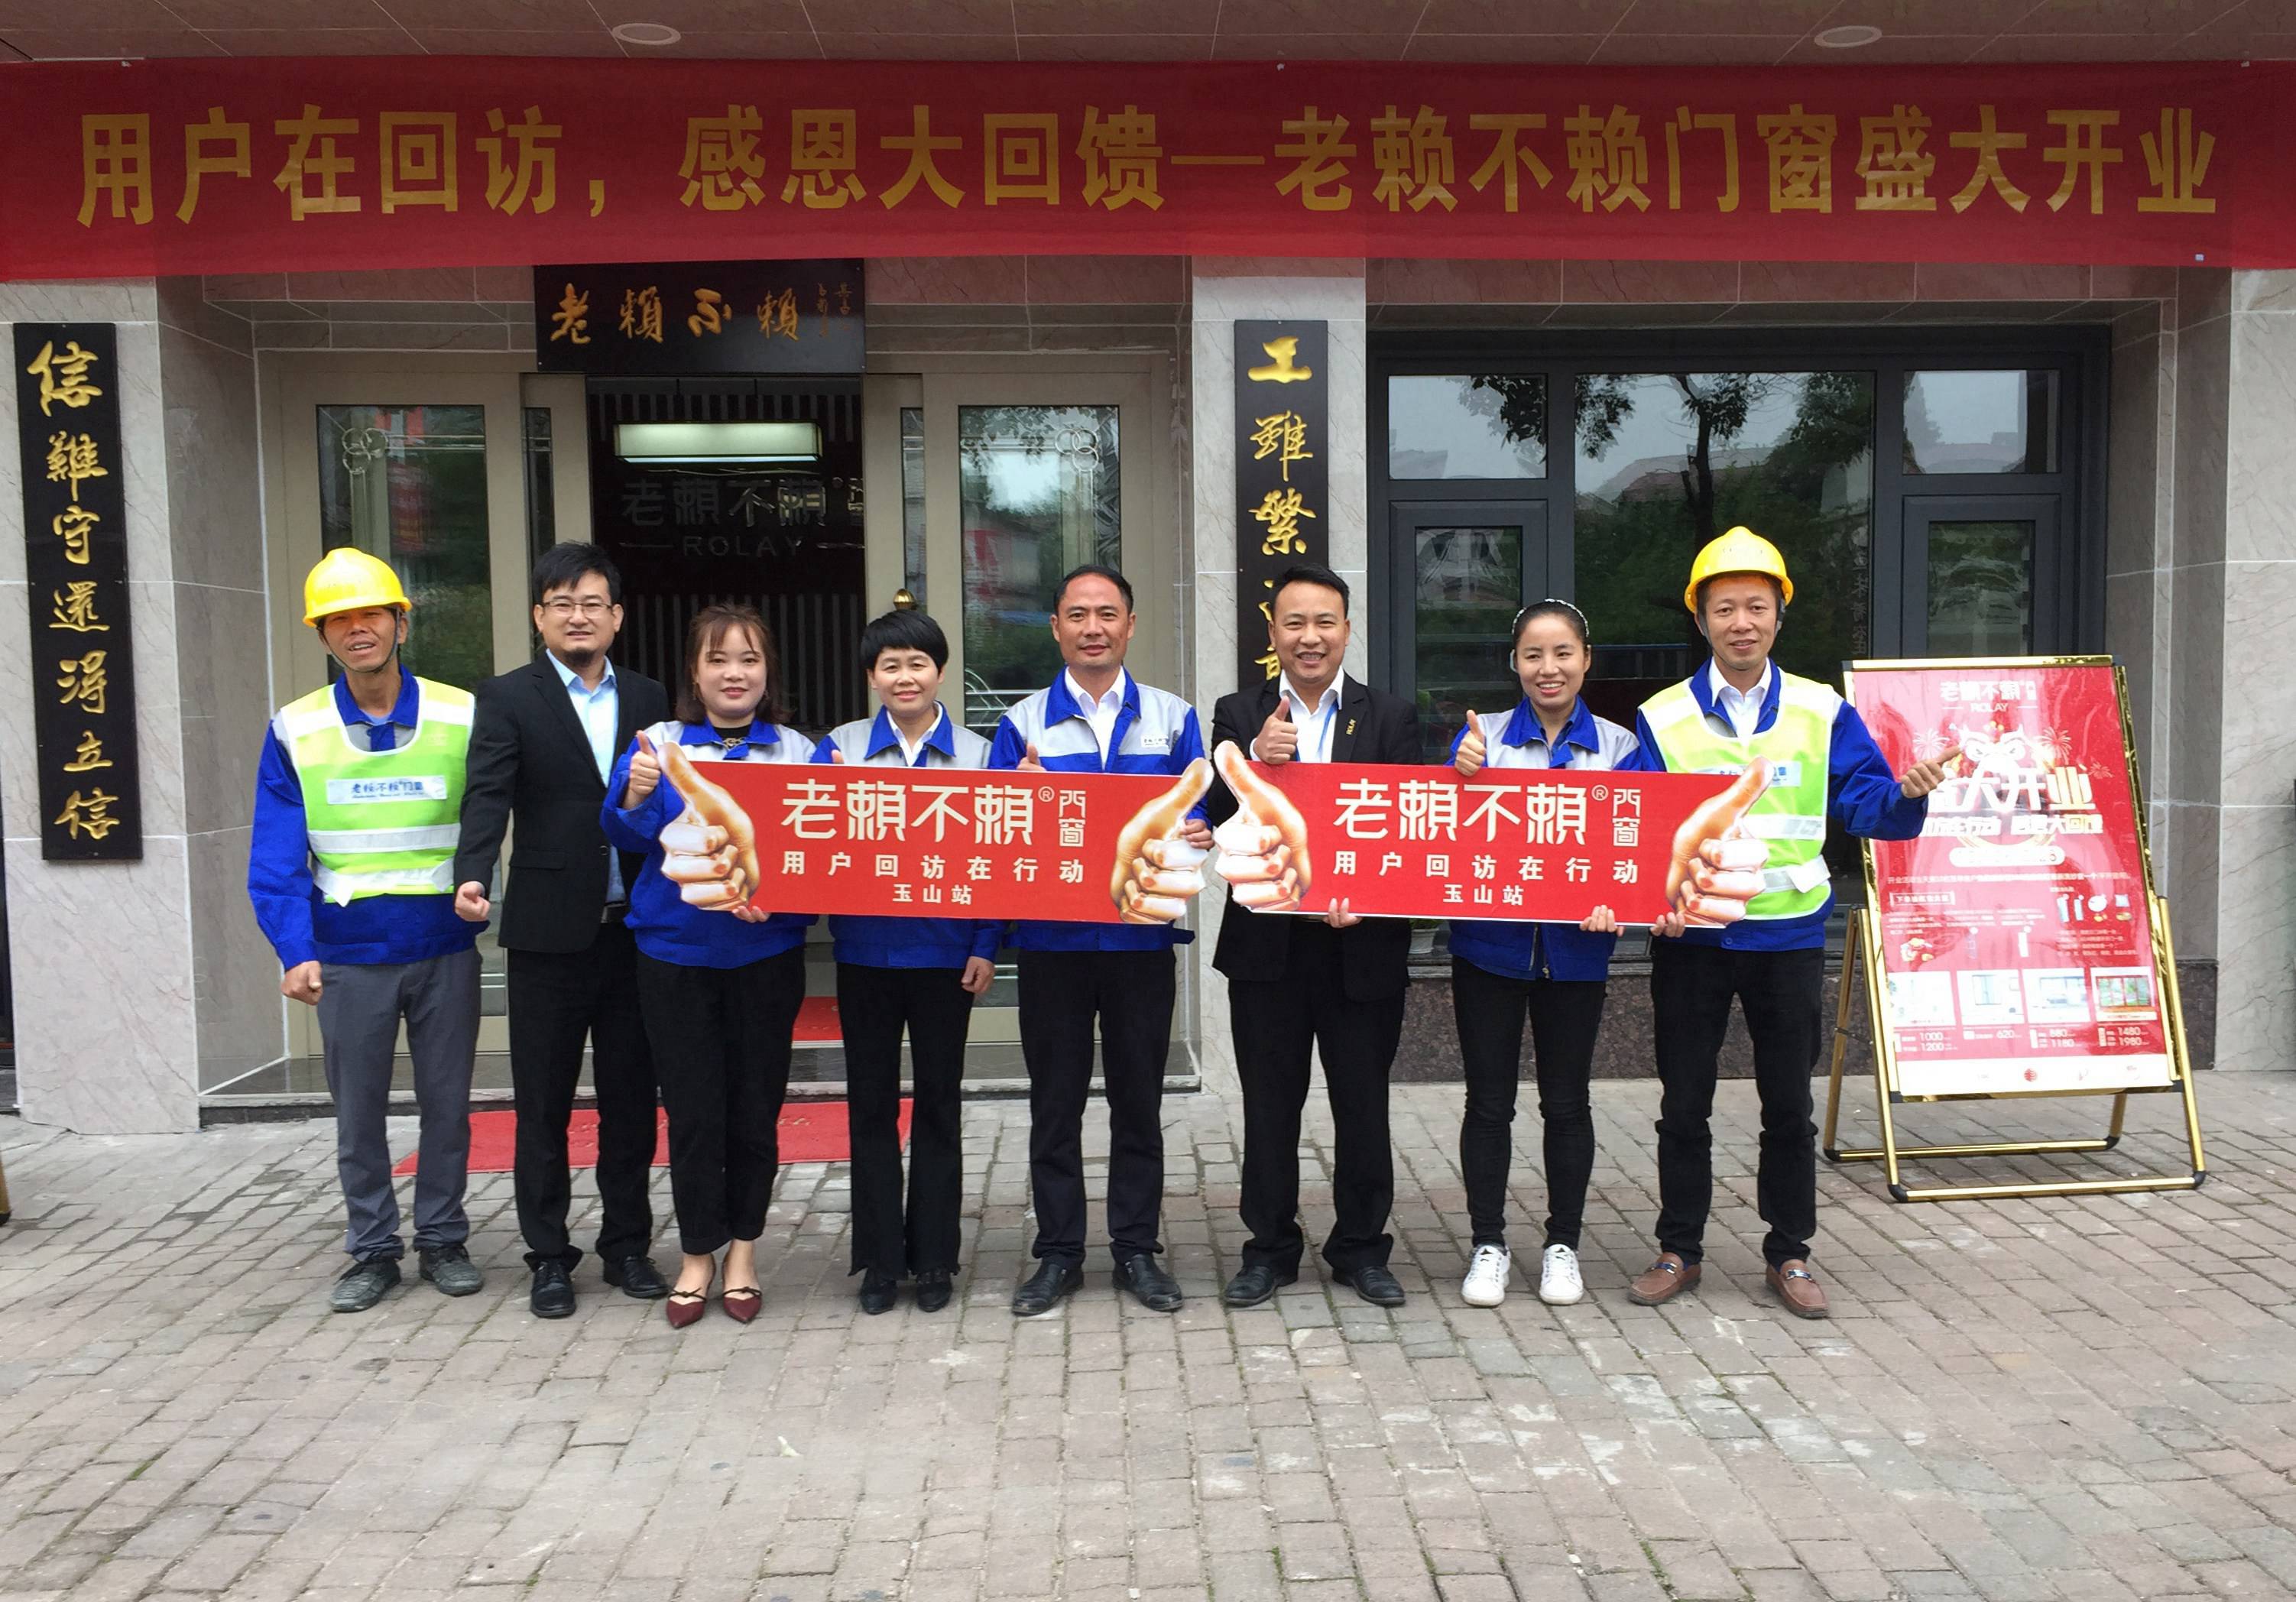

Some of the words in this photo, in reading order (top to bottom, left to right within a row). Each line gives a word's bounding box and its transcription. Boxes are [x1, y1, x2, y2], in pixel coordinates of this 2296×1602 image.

[684, 536, 803, 557] ROLAY
[782, 851, 1084, 884] 用户回访在行动
[1334, 851, 1638, 884] 用户回访在行动
[893, 884, 972, 906] 玉山站
[1443, 884, 1523, 906] 玉山站
